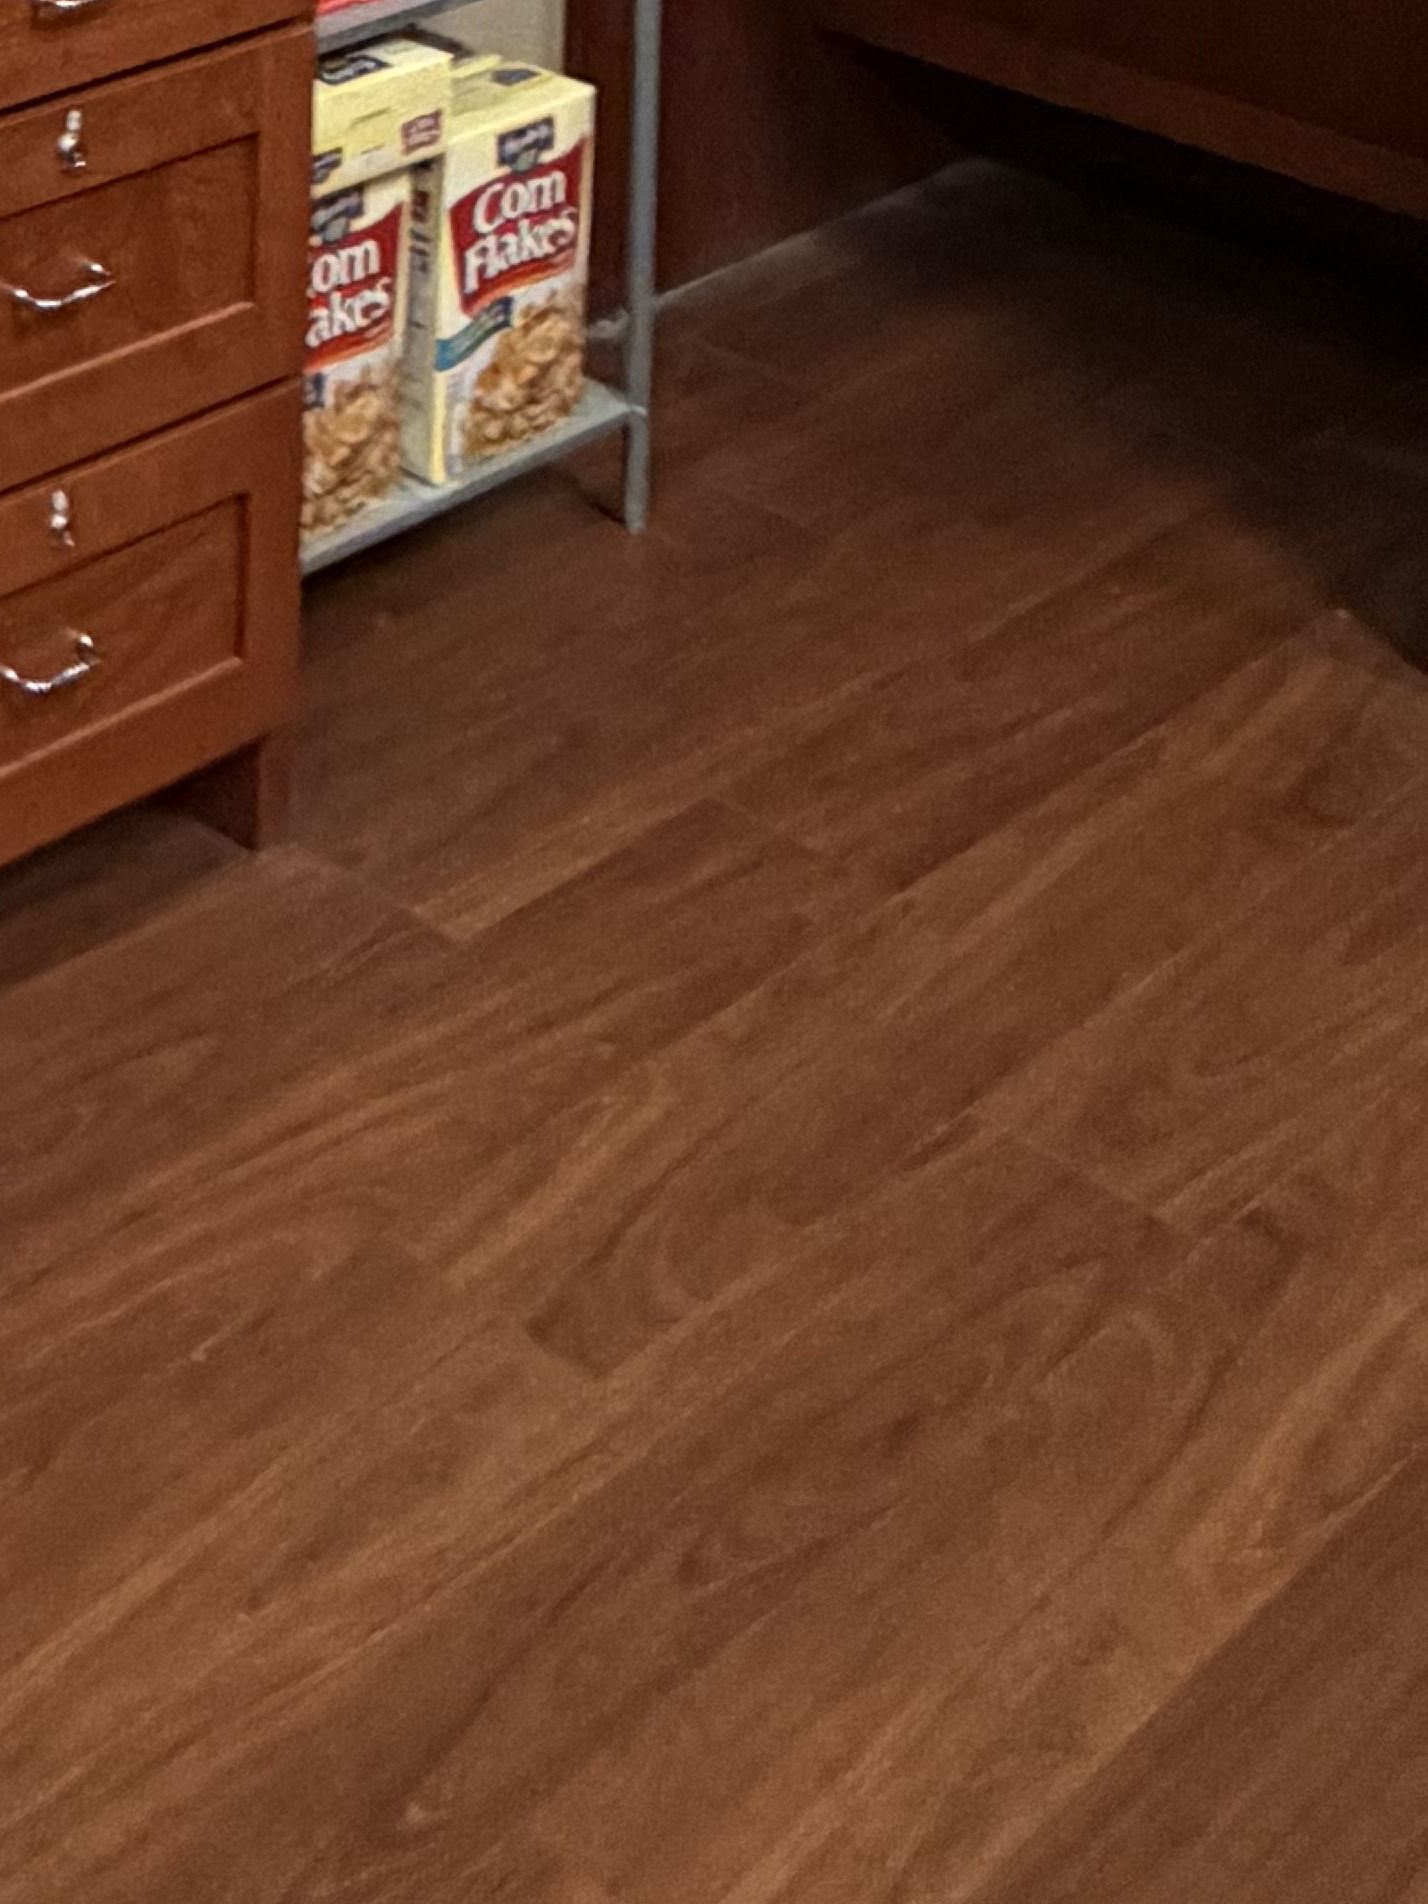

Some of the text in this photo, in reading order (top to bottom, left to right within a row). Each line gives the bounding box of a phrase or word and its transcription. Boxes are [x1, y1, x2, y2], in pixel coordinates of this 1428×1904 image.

[472, 170, 568, 235] Corn
[311, 239, 381, 293] orn
[463, 205, 578, 296] Flakes
[305, 275, 393, 349] akes
